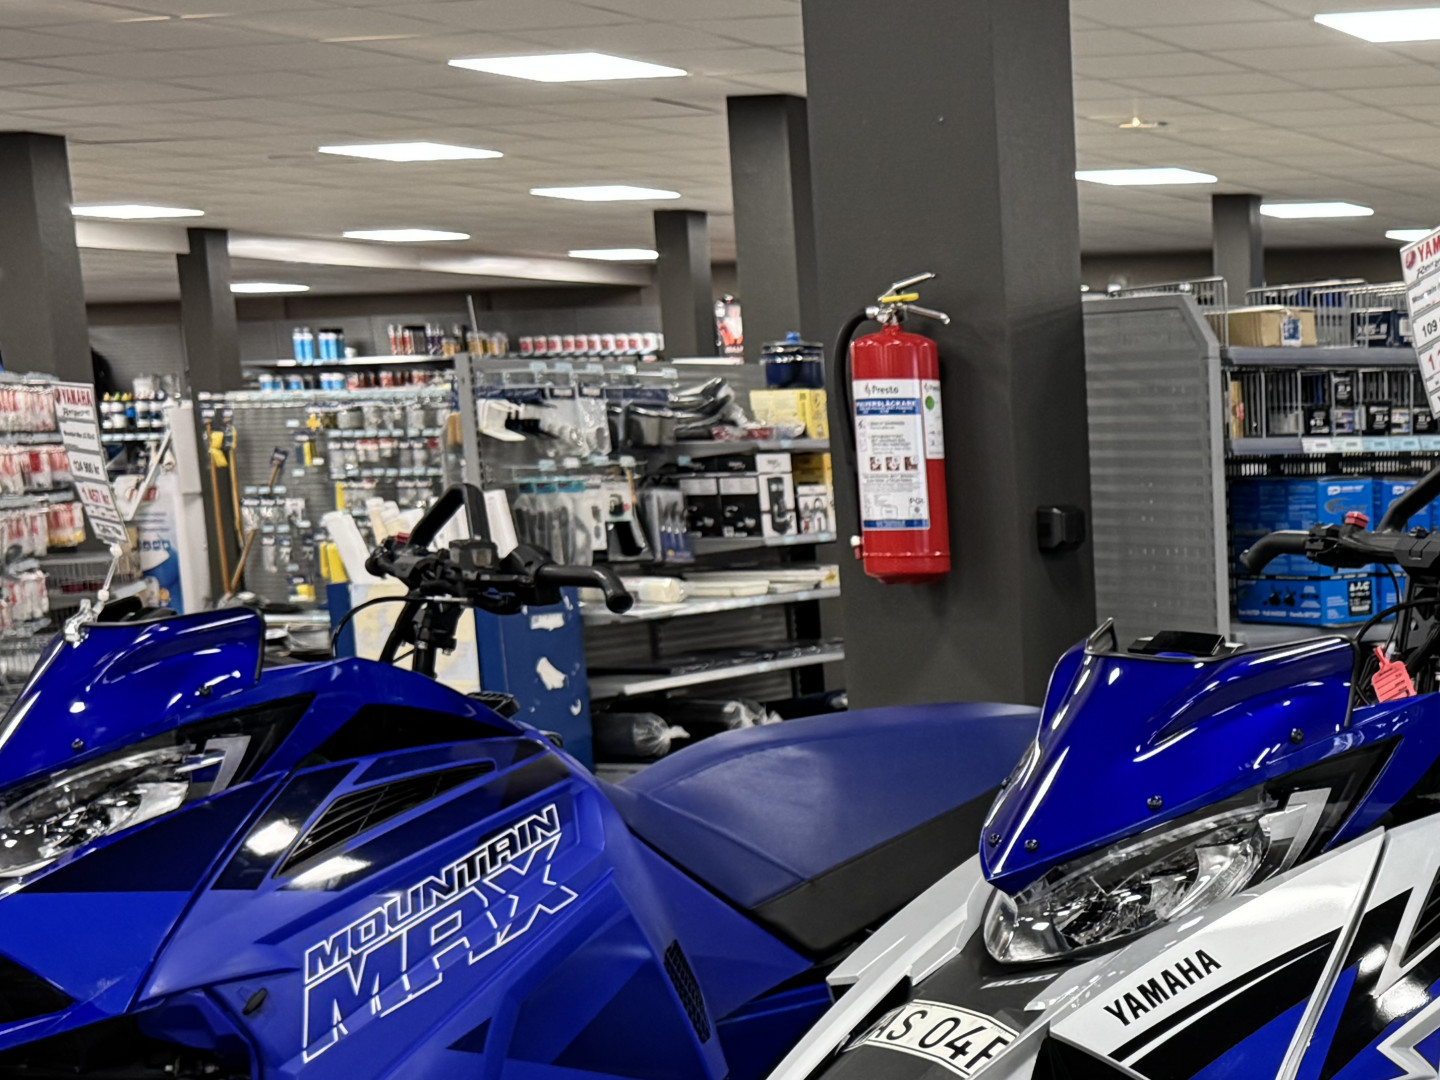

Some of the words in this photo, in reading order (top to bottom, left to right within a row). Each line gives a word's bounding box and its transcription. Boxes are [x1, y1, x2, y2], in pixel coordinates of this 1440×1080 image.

[1422, 320, 1438, 337] 109
[1428, 354, 1436, 371] 1
[62, 388, 94, 406] YAMAHA
[872, 385, 899, 395] Presto
[305, 803, 561, 986] MOUNTAIN
[302, 833, 578, 1064] MAX
[1103, 949, 1222, 1027] YAMAHA
